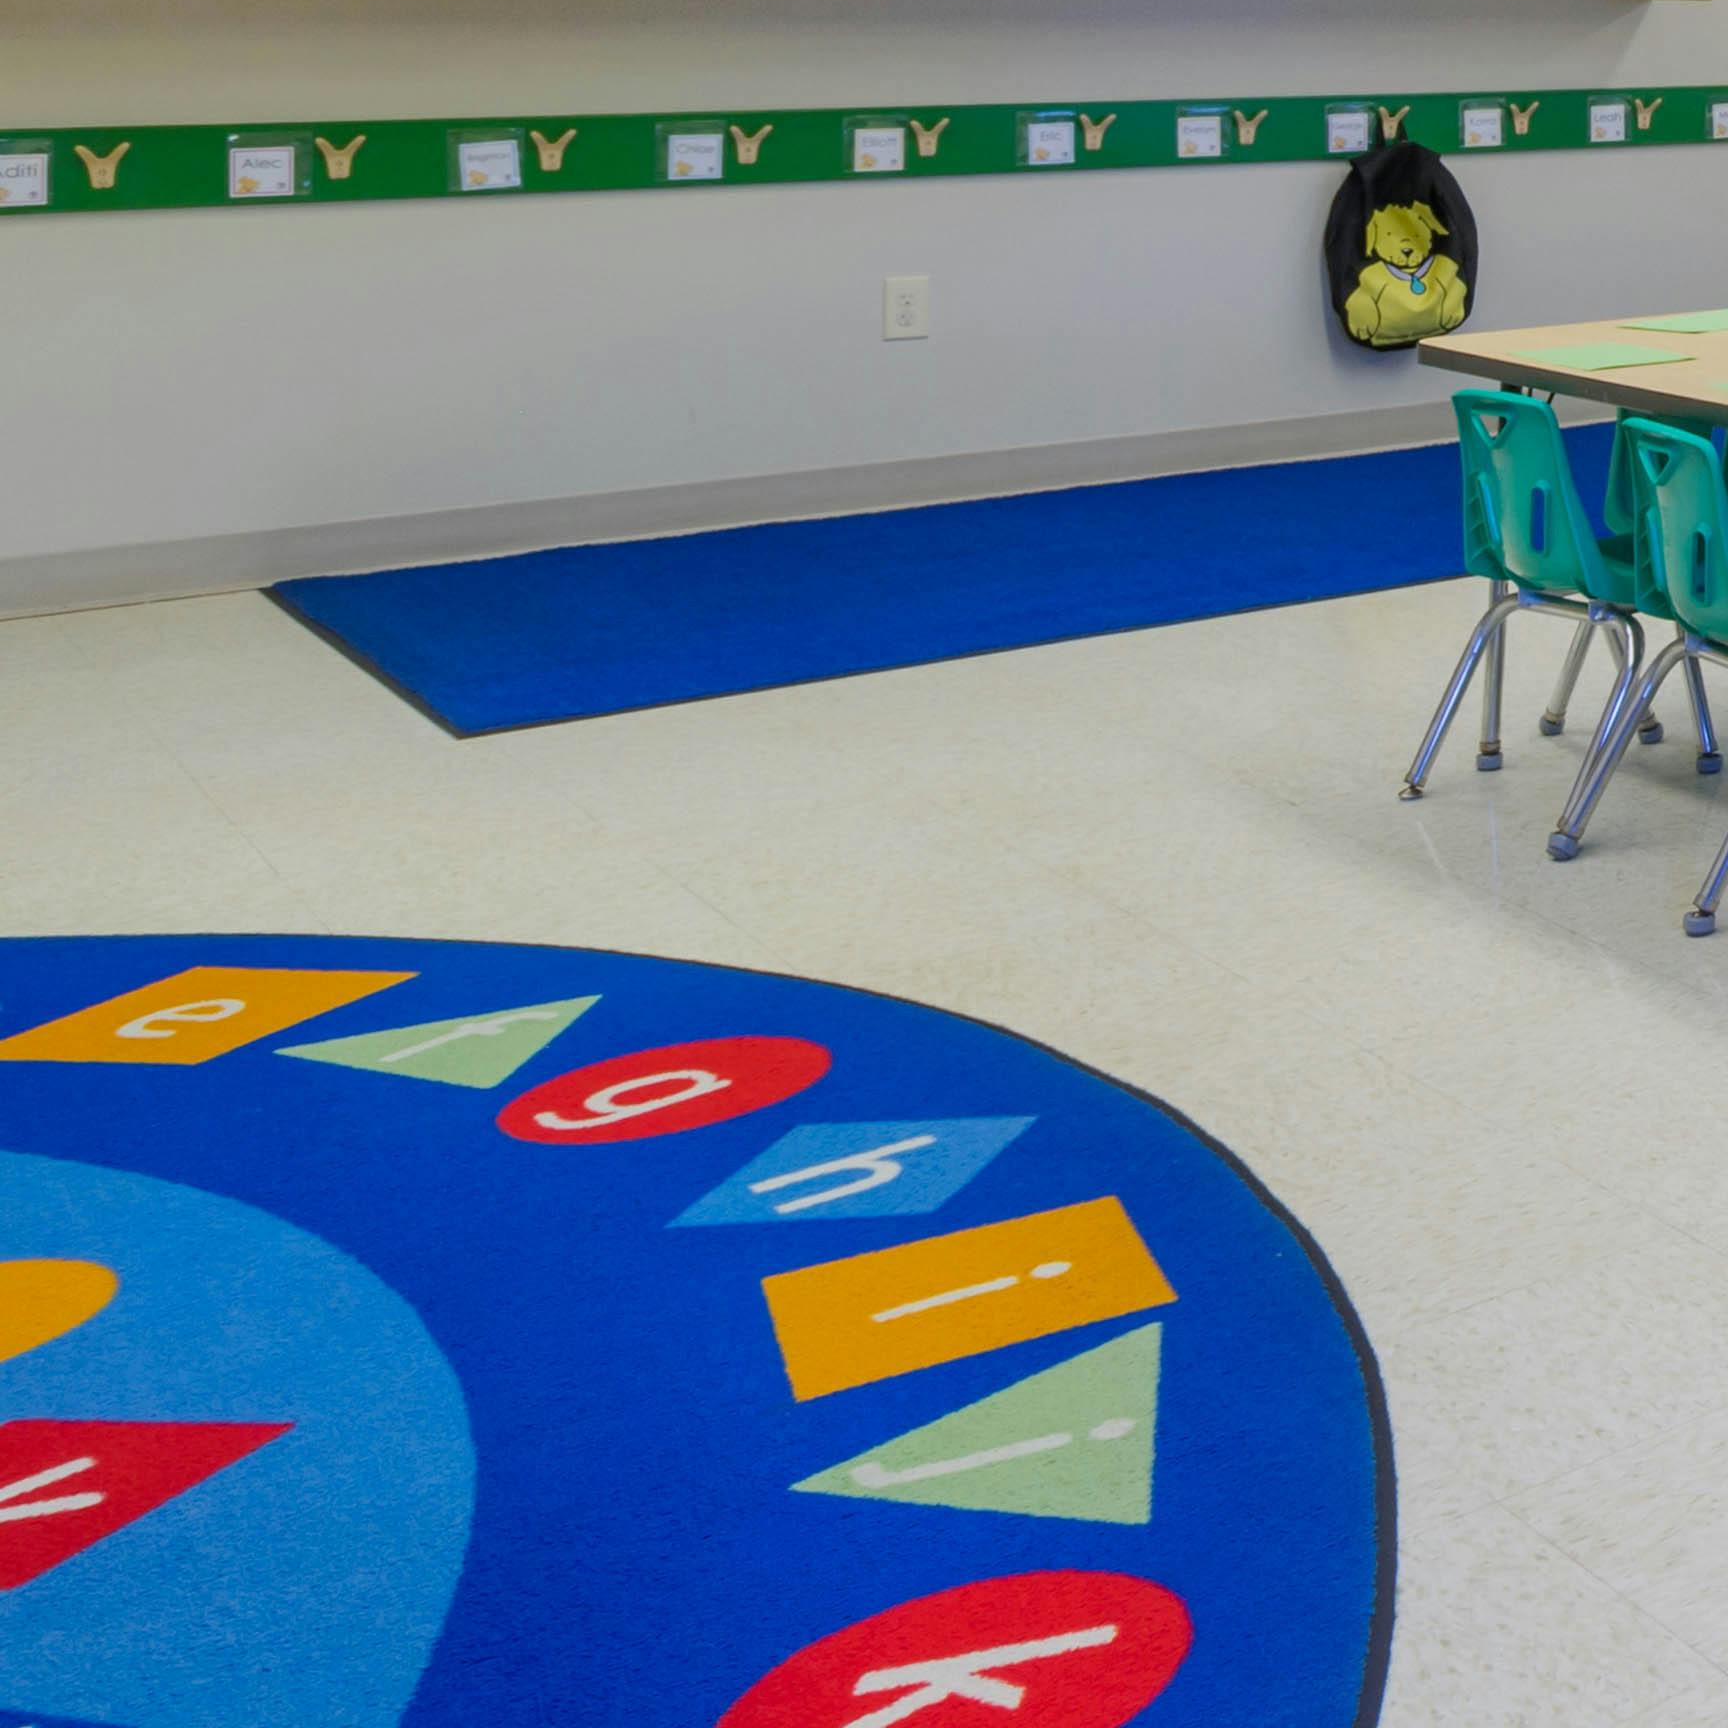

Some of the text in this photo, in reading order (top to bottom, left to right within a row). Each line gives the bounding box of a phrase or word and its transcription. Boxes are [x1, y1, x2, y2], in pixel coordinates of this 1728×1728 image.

[114, 998, 1136, 1728] e f g h i j k
